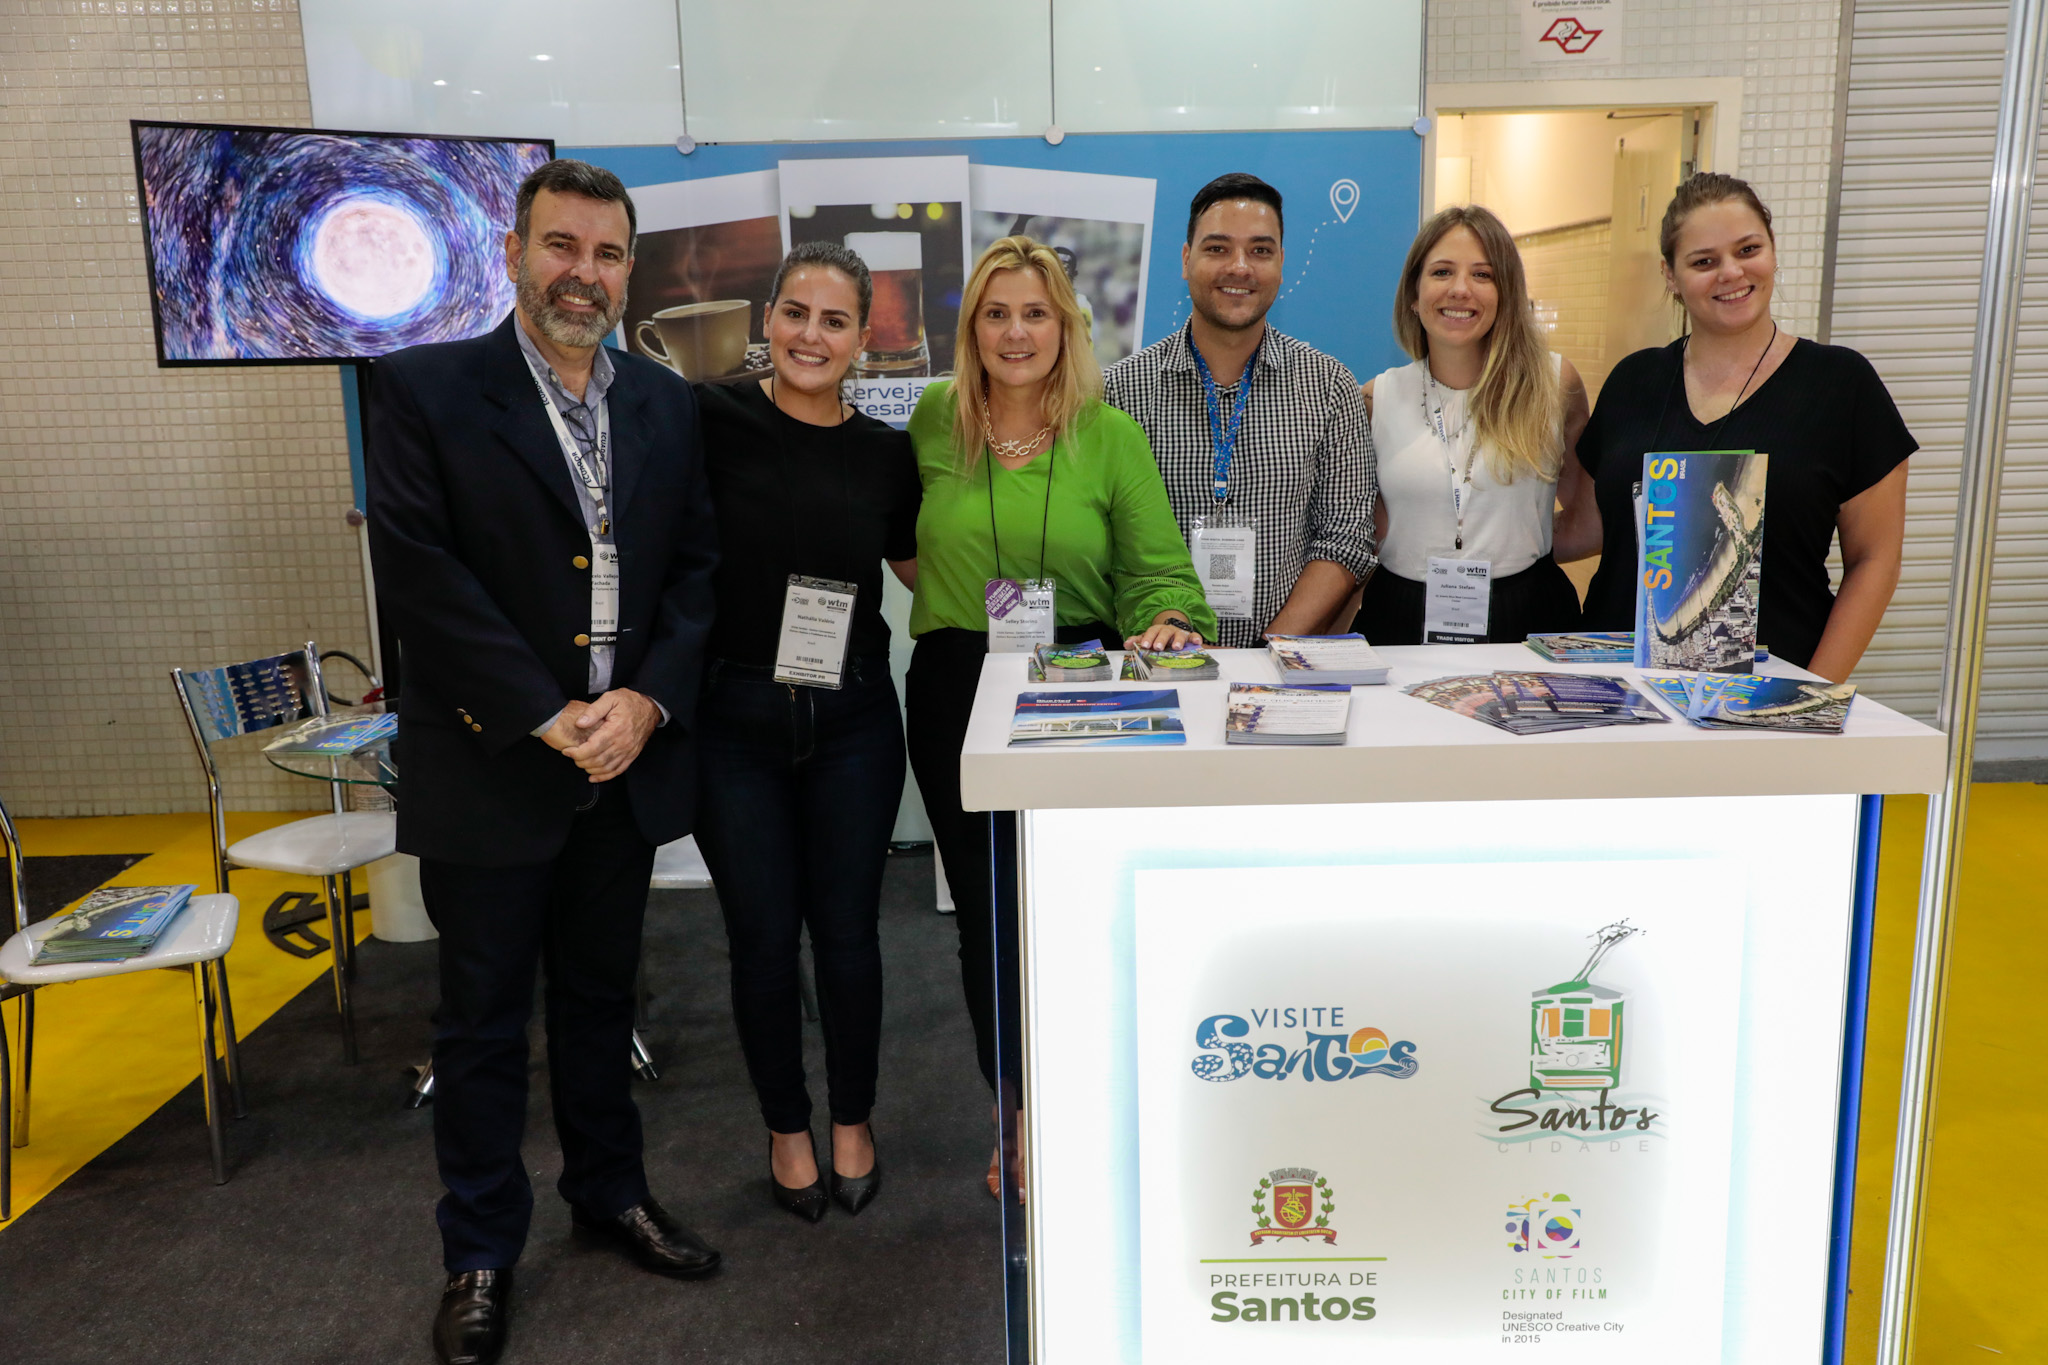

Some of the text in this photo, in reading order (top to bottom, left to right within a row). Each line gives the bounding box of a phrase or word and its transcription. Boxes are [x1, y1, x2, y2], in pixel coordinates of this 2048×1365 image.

[571, 451, 592, 484] ECUADOR
[1643, 457, 1679, 590] SANTOS
[1466, 566, 1487, 574] wtm
[827, 598, 848, 608] wtm
[990, 587, 1016, 614] MULHERES
[1029, 598, 1050, 606] wtm
[788, 670, 817, 678] EXHIBITOR
[1718, 673, 1763, 704] SANTOS
[107, 902, 167, 937] SANTOS
[1251, 1007, 1344, 1028] VISITE
[1490, 1087, 1659, 1132] Santos
[1497, 1139, 1649, 1153] CIDADE
[1210, 1272, 1377, 1287] PREFEITURA DE
[1514, 1267, 1602, 1284] SANTOS
[1502, 1288, 1607, 1300] CITY OF FILM
[1210, 1291, 1376, 1322] Santos
[1502, 1310, 1562, 1322] Designated
[1502, 1321, 1624, 1333] UNESCO Creative City
[1501, 1334, 1541, 1343] in 2015
